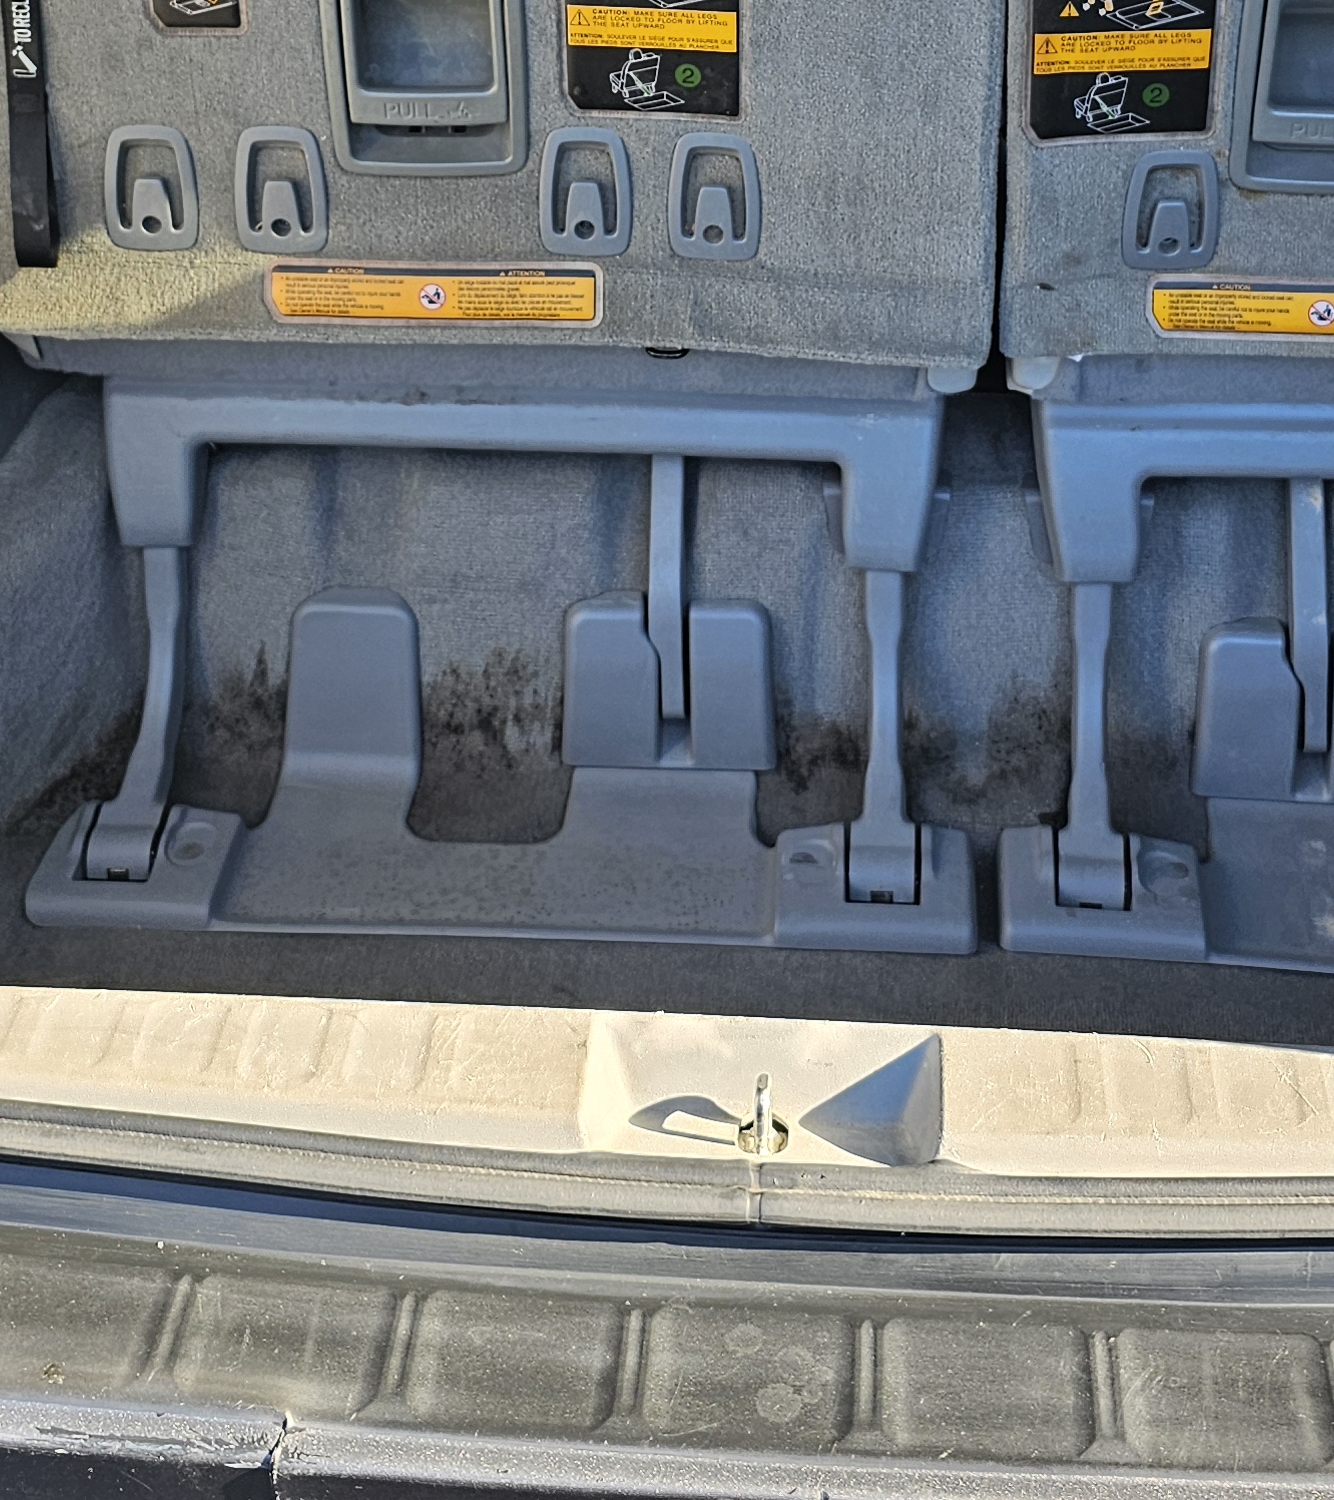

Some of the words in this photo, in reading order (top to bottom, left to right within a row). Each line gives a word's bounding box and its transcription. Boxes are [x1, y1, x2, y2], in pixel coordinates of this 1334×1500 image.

[13, 29, 33, 44] TO
[682, 68, 694, 84] 2
[1150, 87, 1163, 102] 2
[383, 102, 436, 120] PULL
